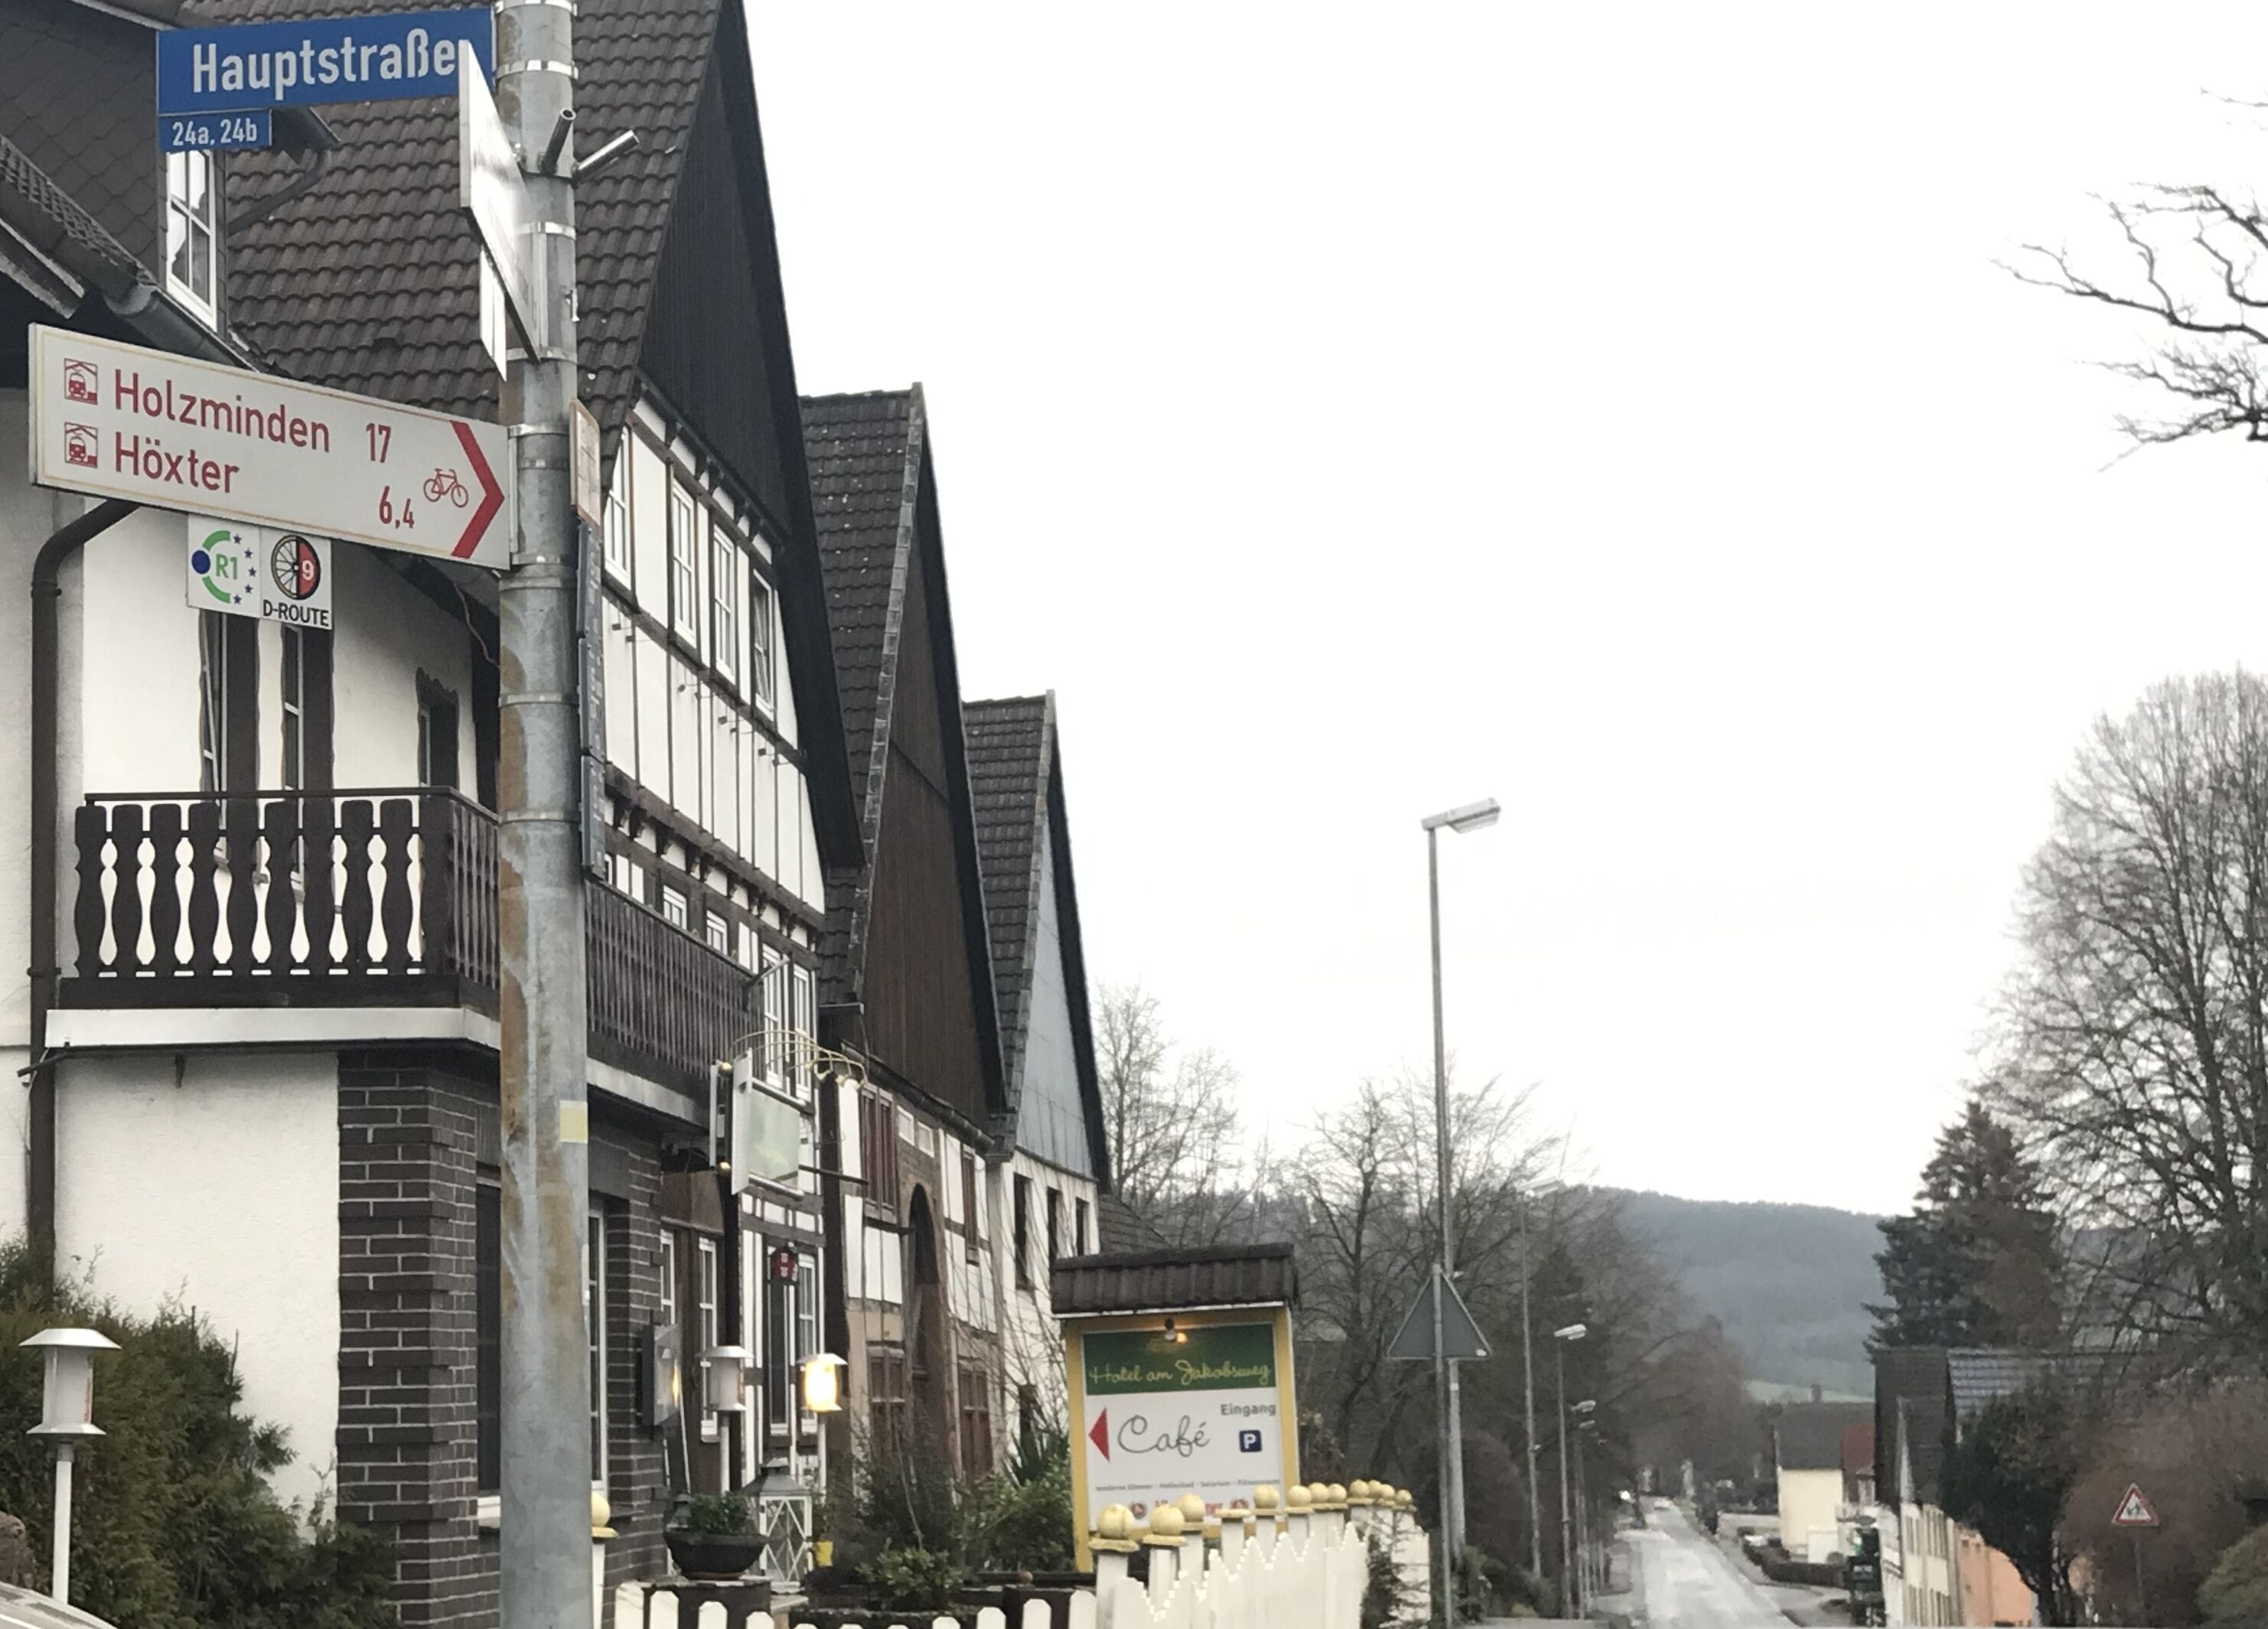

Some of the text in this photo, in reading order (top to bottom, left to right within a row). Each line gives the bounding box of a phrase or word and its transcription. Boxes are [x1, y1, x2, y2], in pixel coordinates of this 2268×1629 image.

[193, 28, 456, 101] Hauptstraße
[220, 118, 257, 142] 24b
[115, 369, 392, 464] Holzminden 17
[115, 431, 415, 529] Höxter 6,4
[216, 553, 238, 580] R1
[301, 560, 314, 582] 9
[263, 599, 329, 627] D-ROUTE
[1089, 1363, 1142, 1383] Hotel
[1146, 1370, 1173, 1382] am
[1220, 1403, 1276, 1417] Eingang
[1118, 1415, 1211, 1458] Café
[1243, 1433, 1256, 1449] P
